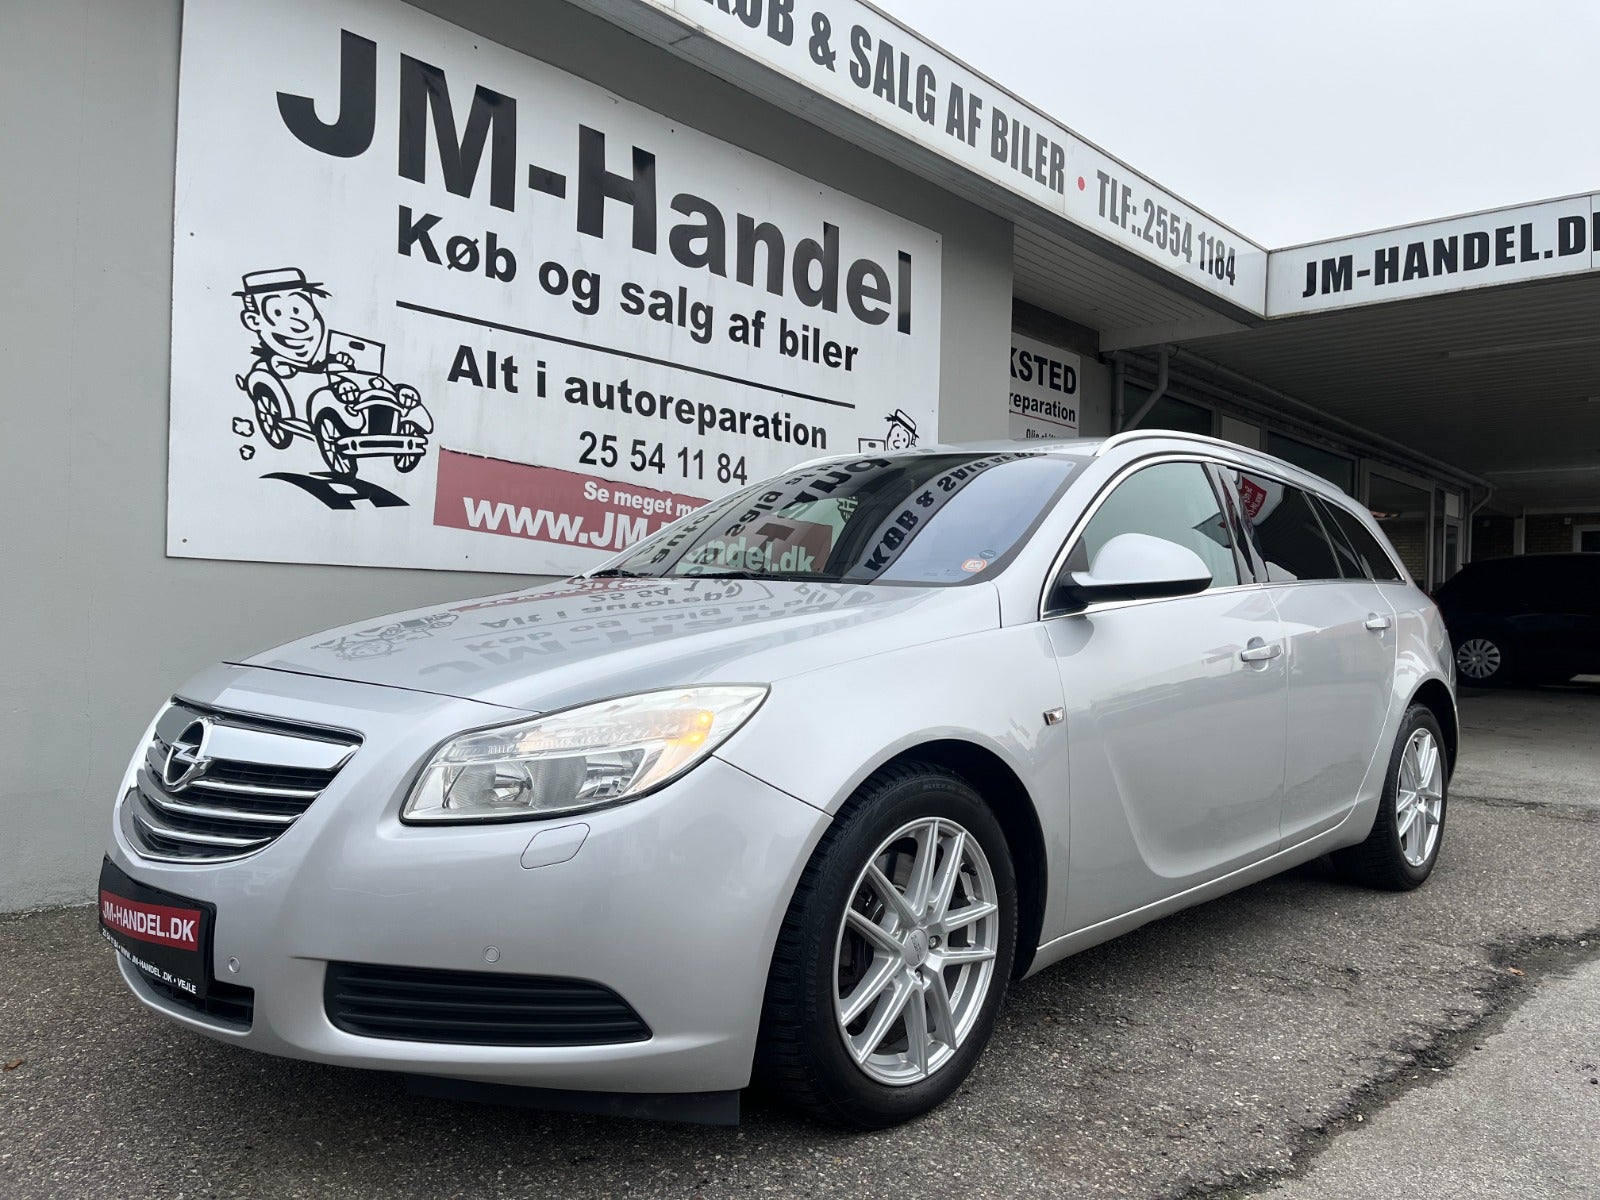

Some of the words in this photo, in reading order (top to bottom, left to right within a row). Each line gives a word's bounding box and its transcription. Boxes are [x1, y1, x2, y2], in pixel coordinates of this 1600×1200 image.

[276, 29, 911, 335] JM-Handel
[809, 12, 835, 72] &
[850, 25, 935, 125] SALG
[945, 82, 982, 147] AF
[991, 107, 1064, 194] BILER
[1198, 231, 1236, 286] 1184
[398, 205, 516, 282] Køb
[539, 262, 600, 315] og
[620, 283, 713, 344] salg
[729, 310, 766, 348] af
[780, 318, 858, 371] biler
[1303, 211, 1600, 298] JM-HANDEL.D
[447, 345, 518, 393] Alt
[537, 360, 546, 398] i
[565, 377, 826, 449] autoreparation
[579, 431, 617, 467] 25
[630, 439, 665, 474] 54
[678, 447, 703, 480] 11
[717, 453, 747, 485] 84
[584, 481, 609, 502] Se
[614, 491, 672, 515] meget
[102, 901, 195, 942] JM-HANDEL.DK
